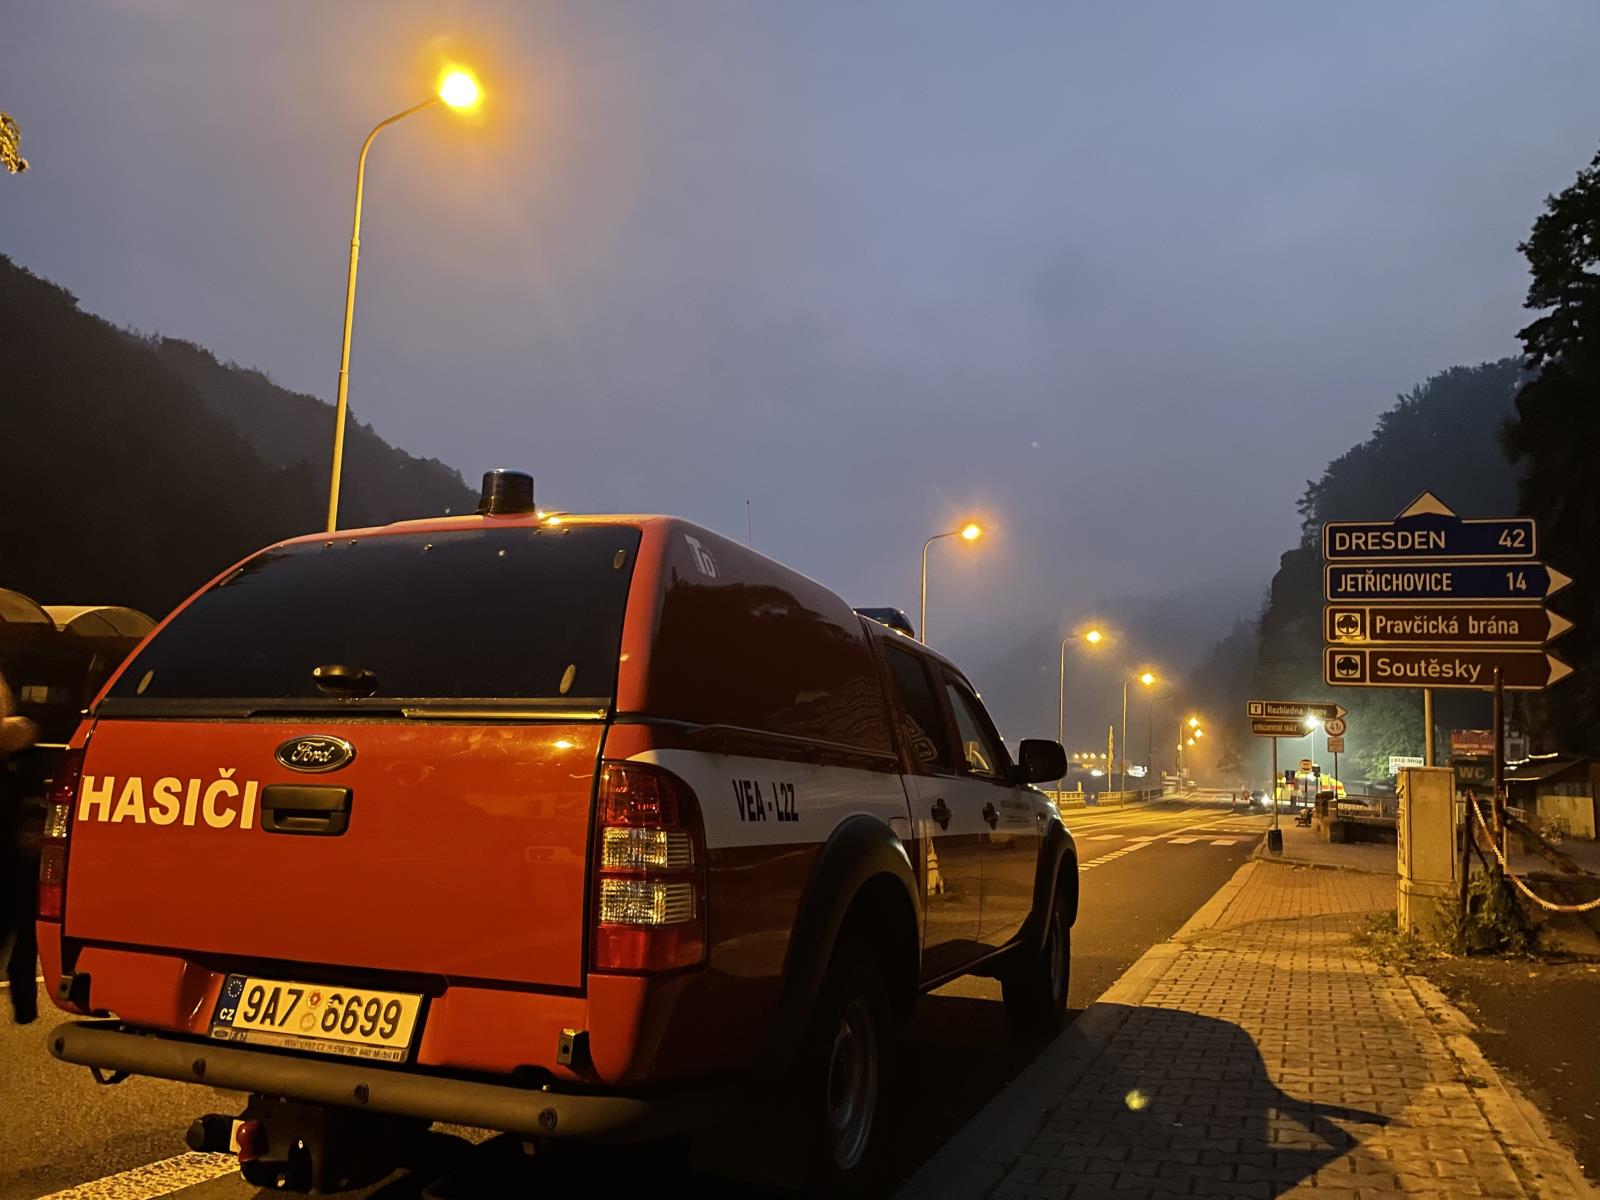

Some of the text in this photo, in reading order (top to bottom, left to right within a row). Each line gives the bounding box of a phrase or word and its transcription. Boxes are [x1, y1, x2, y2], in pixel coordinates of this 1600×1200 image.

[1335, 528, 1526, 551] DRESDEN 42
[1336, 569, 1527, 592] JETŘICHOVICE 14
[1375, 614, 1519, 635] Pravčická brána
[1376, 658, 1482, 683] Soutěsky
[1267, 705, 1303, 715] Rozhledna
[291, 741, 333, 763] Ford
[1459, 766, 1485, 779] WC
[78, 767, 259, 829] HASIČI
[732, 779, 767, 822] VEA
[219, 1007, 235, 1021] CZ
[243, 985, 403, 1039] 9A7 6699
